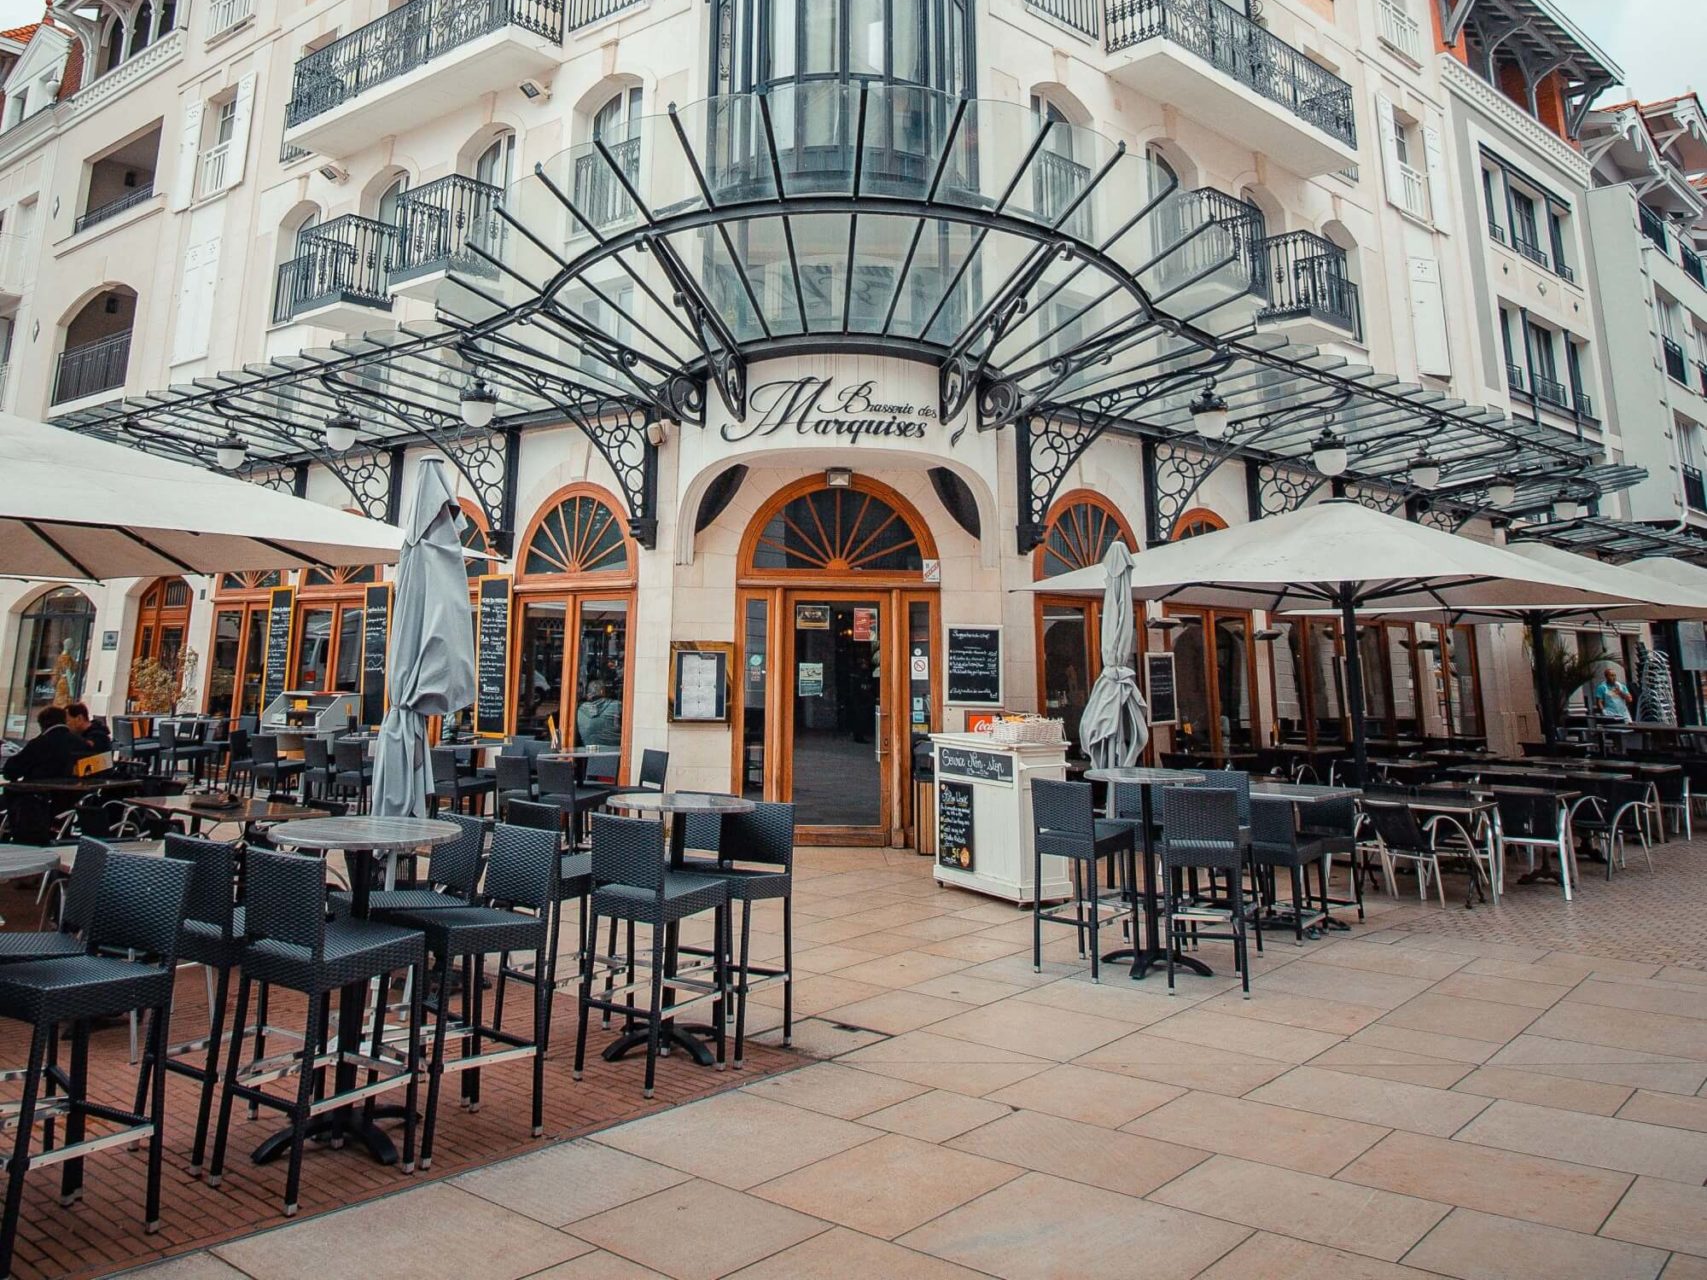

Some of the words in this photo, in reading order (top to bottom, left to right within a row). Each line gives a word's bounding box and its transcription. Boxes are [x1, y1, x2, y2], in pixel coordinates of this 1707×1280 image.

[720, 376, 928, 444] Marquises
[817, 380, 914, 415] Brasserie
[917, 405, 937, 419] des
